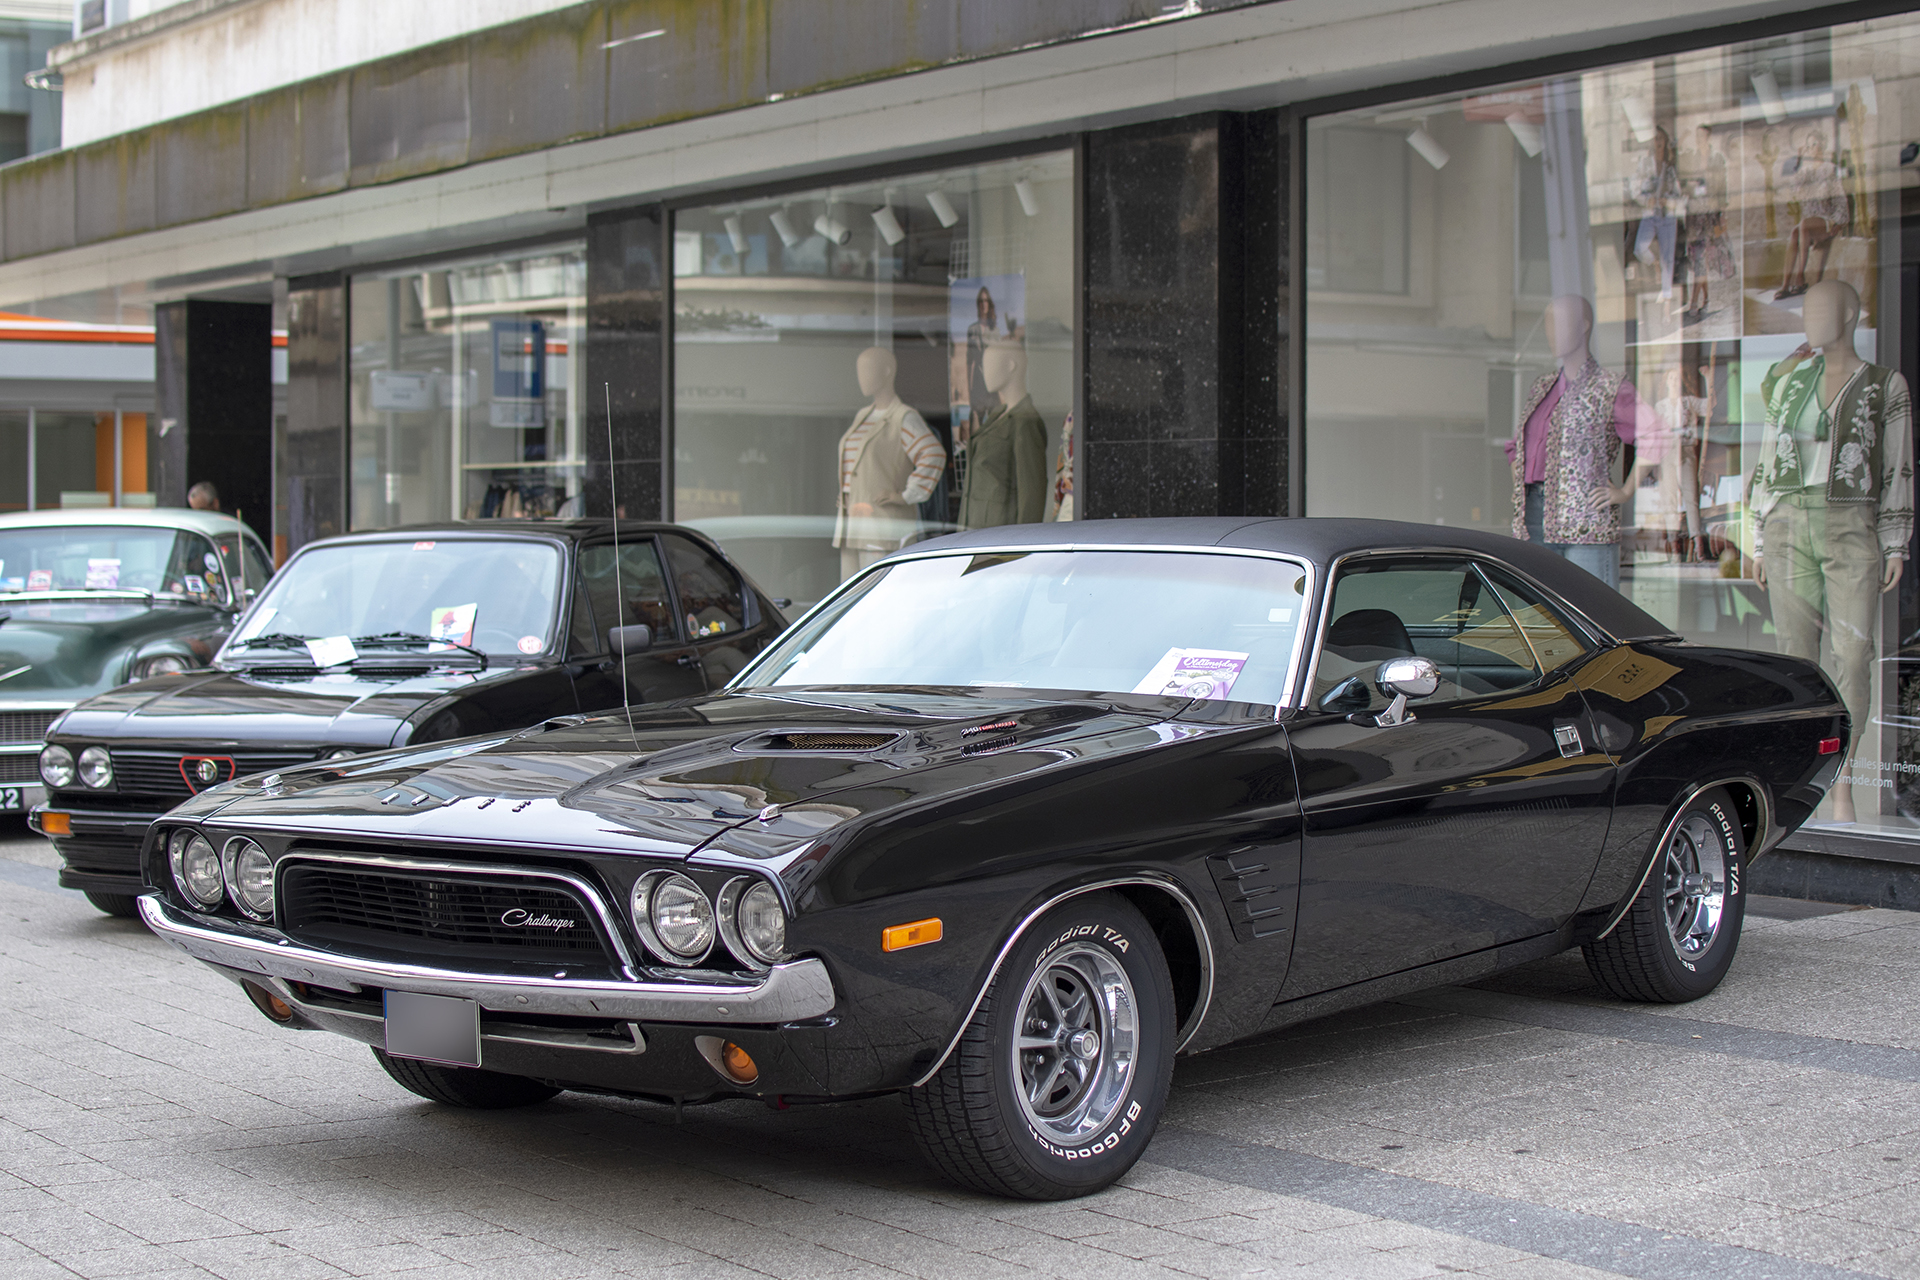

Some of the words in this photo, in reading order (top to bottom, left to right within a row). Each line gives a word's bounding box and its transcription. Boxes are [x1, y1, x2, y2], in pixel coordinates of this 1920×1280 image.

[1849, 757, 1877, 770] tailles
[1879, 761, 1890, 771] au
[1837, 774, 1894, 788] smode.com
[1709, 802, 1737, 856] Radial
[1730, 862, 1740, 896] T/A
[501, 908, 575, 933] Challenger
[1034, 924, 1100, 969] Radial
[1102, 927, 1130, 954] T/A
